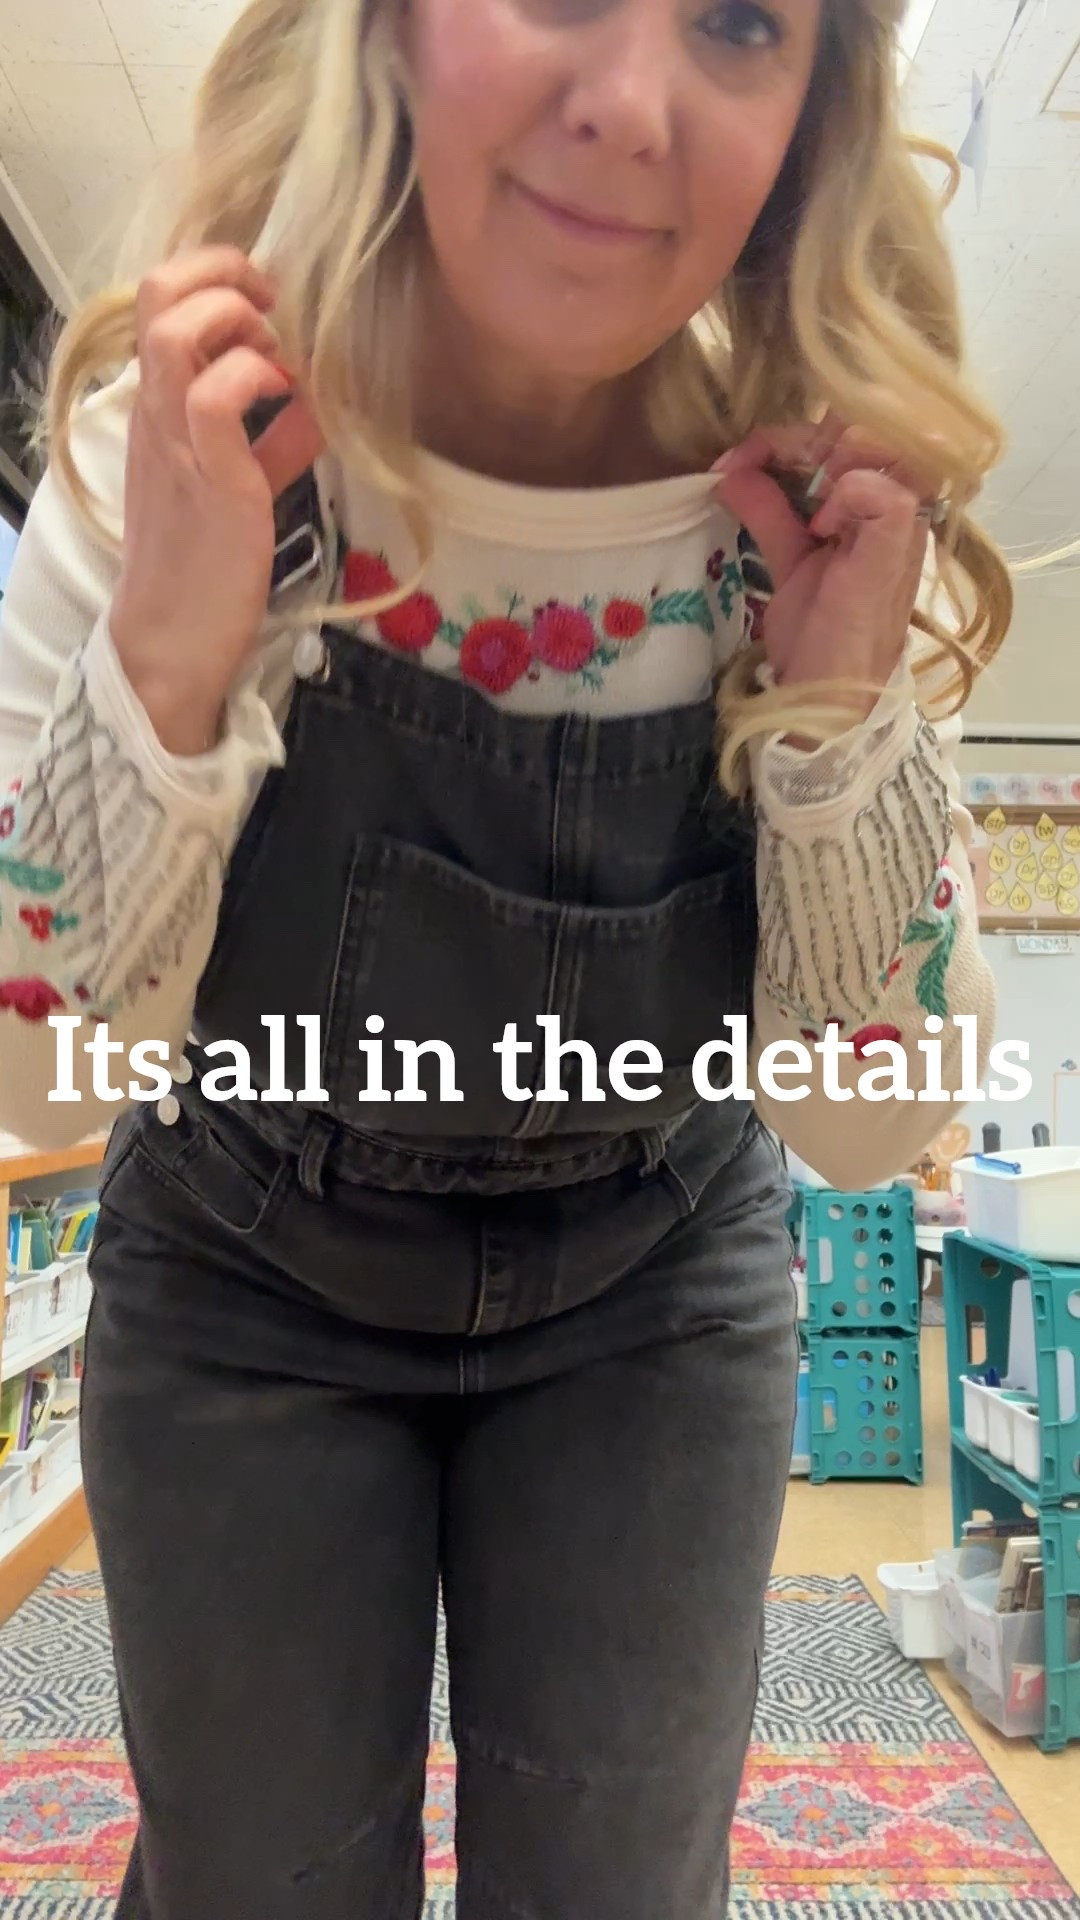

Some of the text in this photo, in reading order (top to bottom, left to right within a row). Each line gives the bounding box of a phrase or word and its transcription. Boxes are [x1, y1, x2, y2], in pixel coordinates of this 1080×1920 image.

[986, 817, 1005, 830] str
[1038, 825, 1054, 837] tw
[1020, 863, 1036, 875] pr
[1011, 893, 1026, 905] dr
